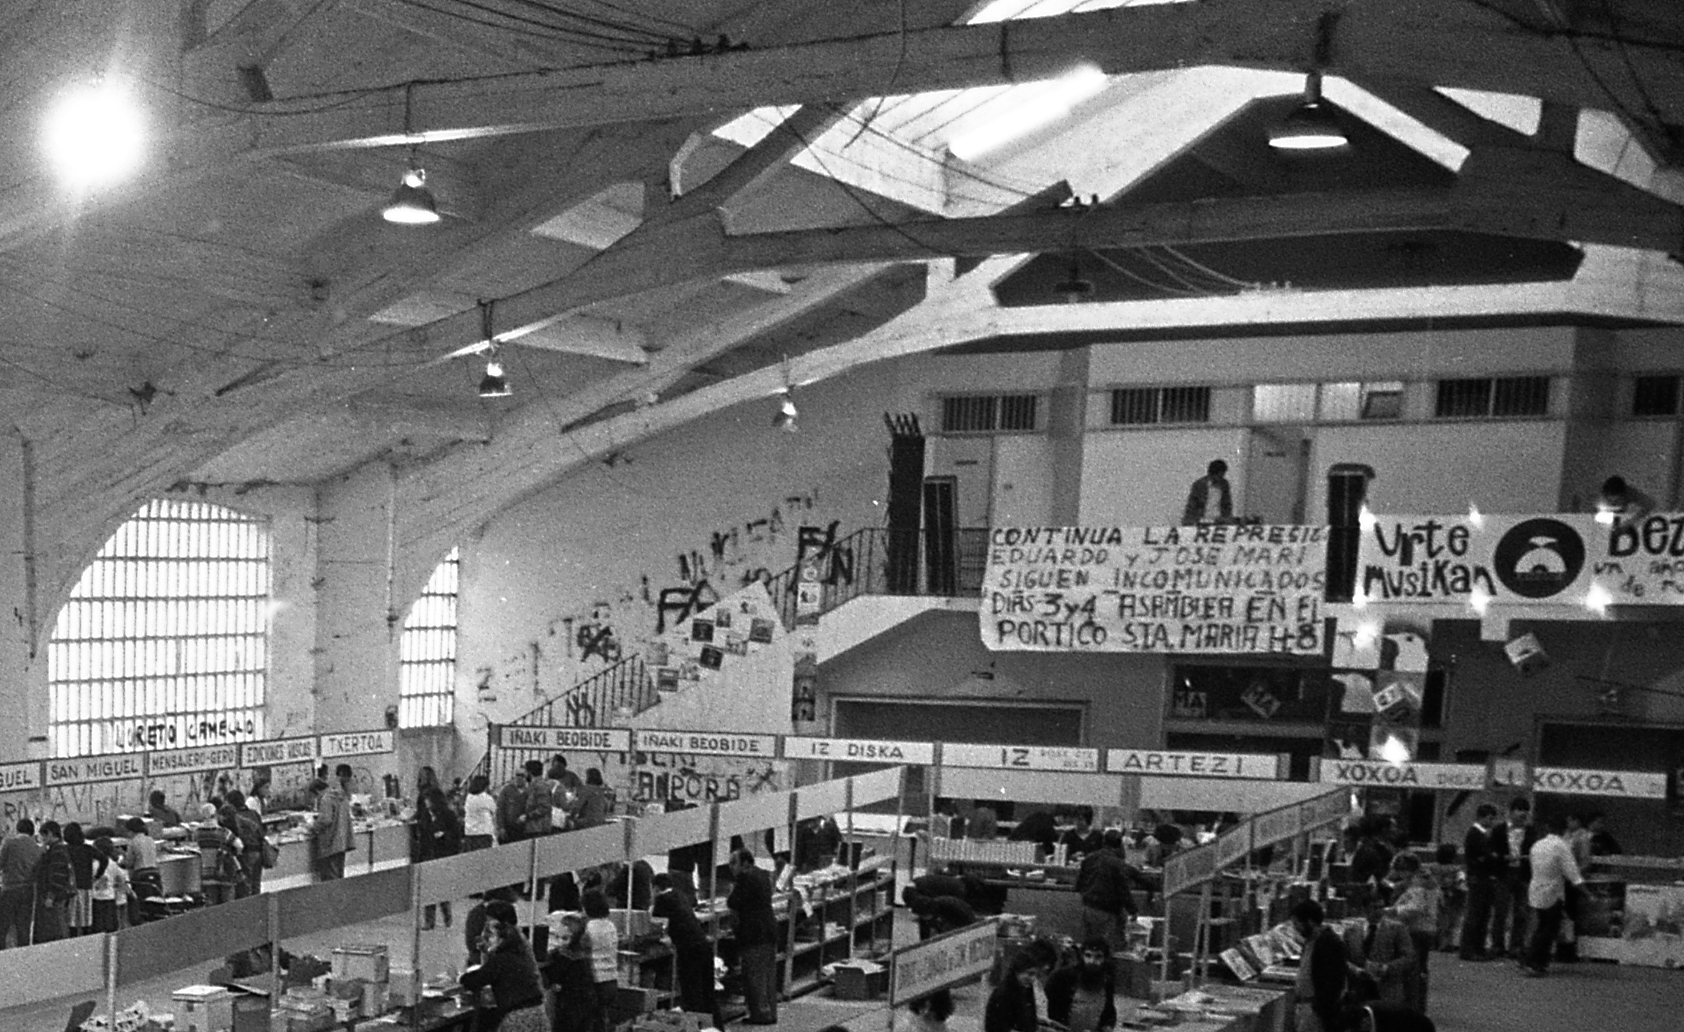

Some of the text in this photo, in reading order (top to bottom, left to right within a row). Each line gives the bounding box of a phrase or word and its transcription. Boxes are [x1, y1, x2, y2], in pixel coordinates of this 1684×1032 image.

[991, 526, 1122, 547] CONTINUA
[1144, 526, 1180, 546] LA
[991, 548, 1109, 566] EDUARDO
[1232, 545, 1307, 567] MARI
[999, 568, 1090, 589] SIGUEN
[1246, 597, 1287, 623] EN
[997, 619, 1108, 646] PORTICO
[1180, 623, 1259, 649] MARIA
[328, 734, 384, 753] TXERTOA
[689, 737, 760, 752] BEOBIDE
[848, 743, 904, 759] DISKA
[1001, 748, 1030, 766] IZ
[1124, 752, 1243, 774] ARTEZI
[50, 759, 139, 781] SAN MIGUEL
[1335, 763, 1418, 783] XOXOA
